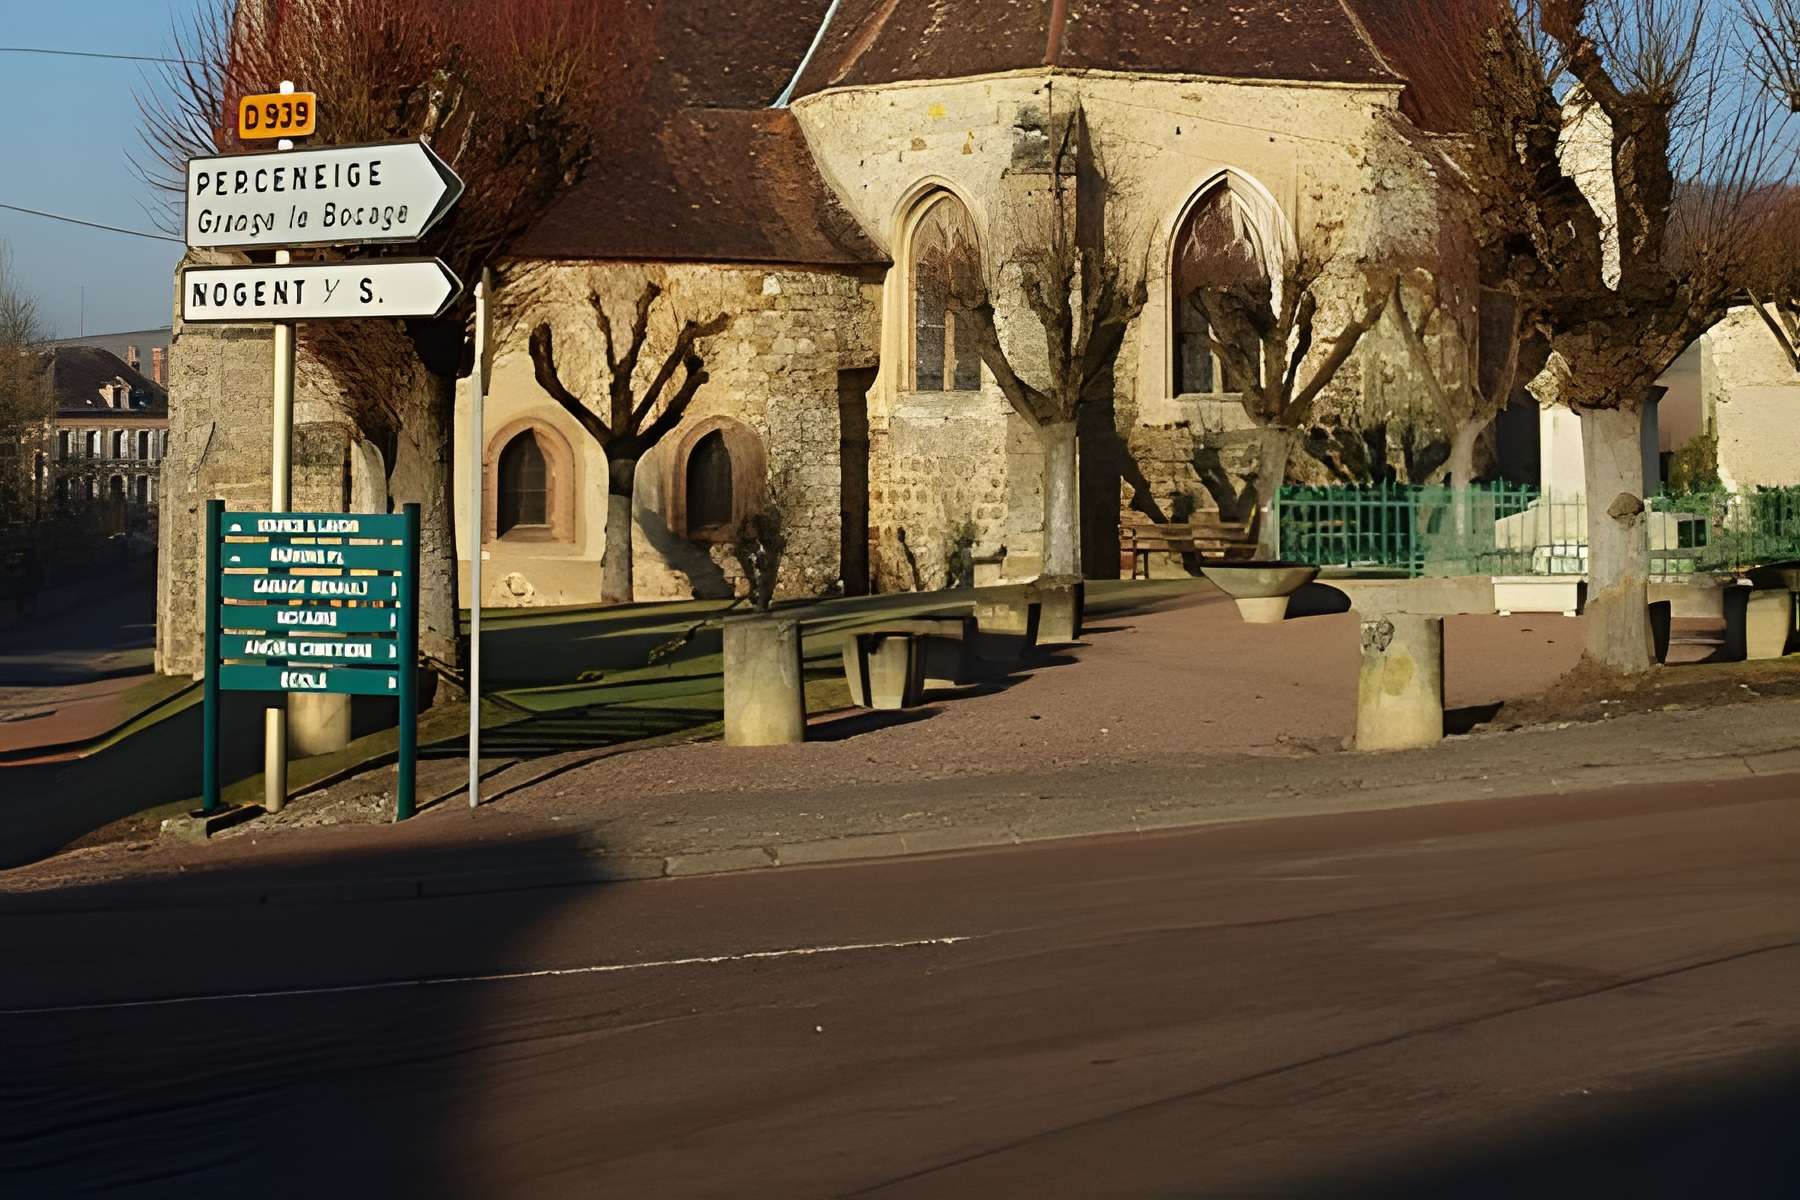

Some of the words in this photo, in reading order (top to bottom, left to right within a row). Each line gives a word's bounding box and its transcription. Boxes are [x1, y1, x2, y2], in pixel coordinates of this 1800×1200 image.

[245, 104, 259, 130] D
[265, 101, 309, 129] 939
[196, 160, 382, 196] PERCENEIGE
[193, 279, 305, 307] NOGENT
[359, 277, 384, 304] S.
